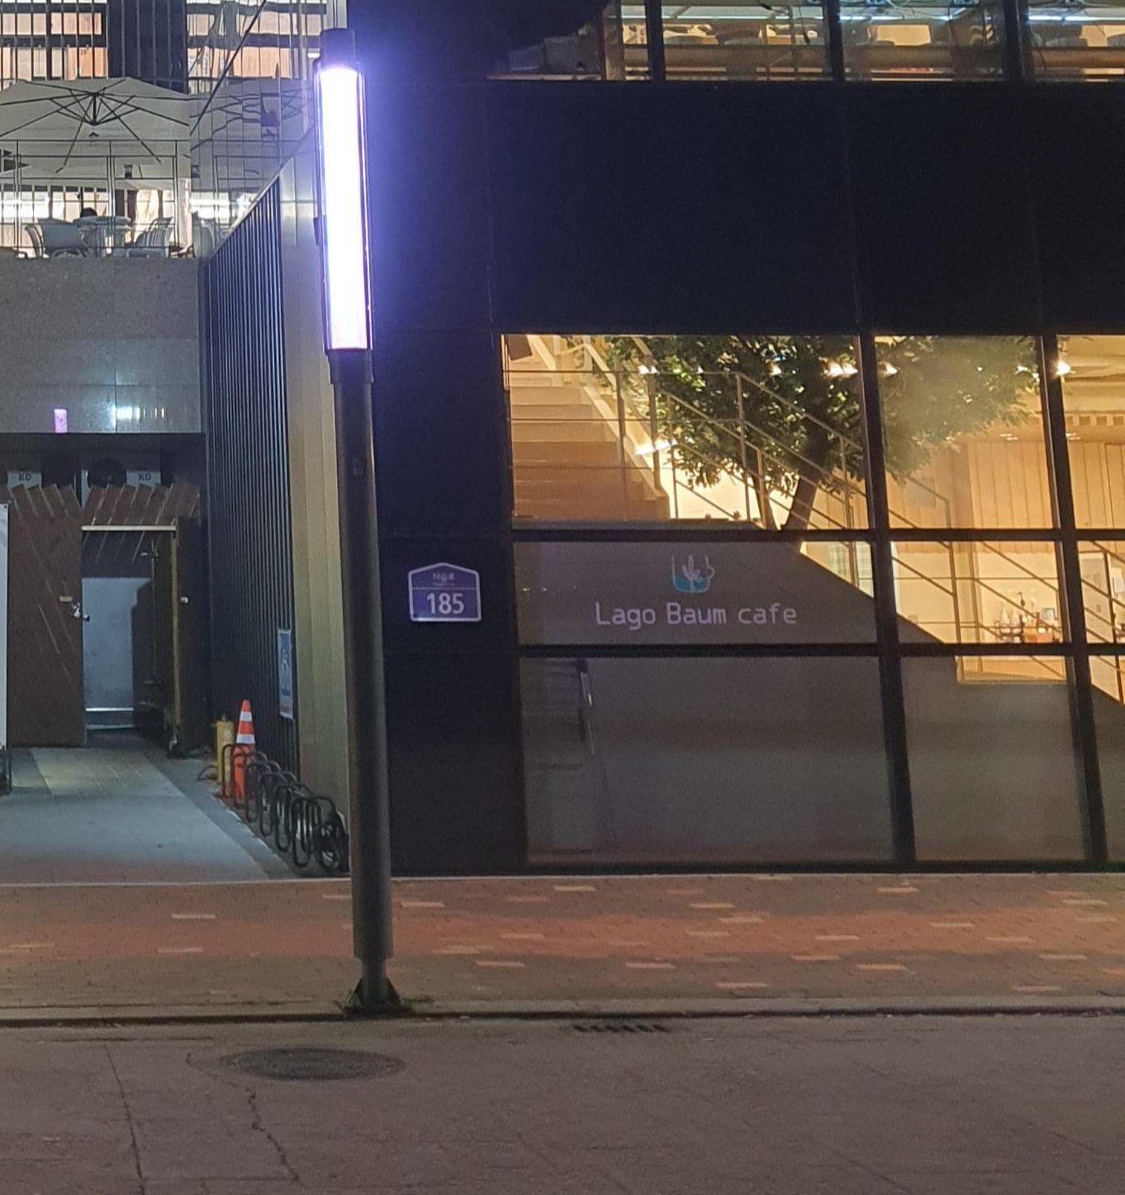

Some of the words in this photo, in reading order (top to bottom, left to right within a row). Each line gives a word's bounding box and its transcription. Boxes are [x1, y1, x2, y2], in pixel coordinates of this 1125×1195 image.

[427, 592, 465, 615] 185
[595, 602, 657, 631] Lago
[665, 602, 726, 625] Baum
[737, 602, 798, 625] cafe
